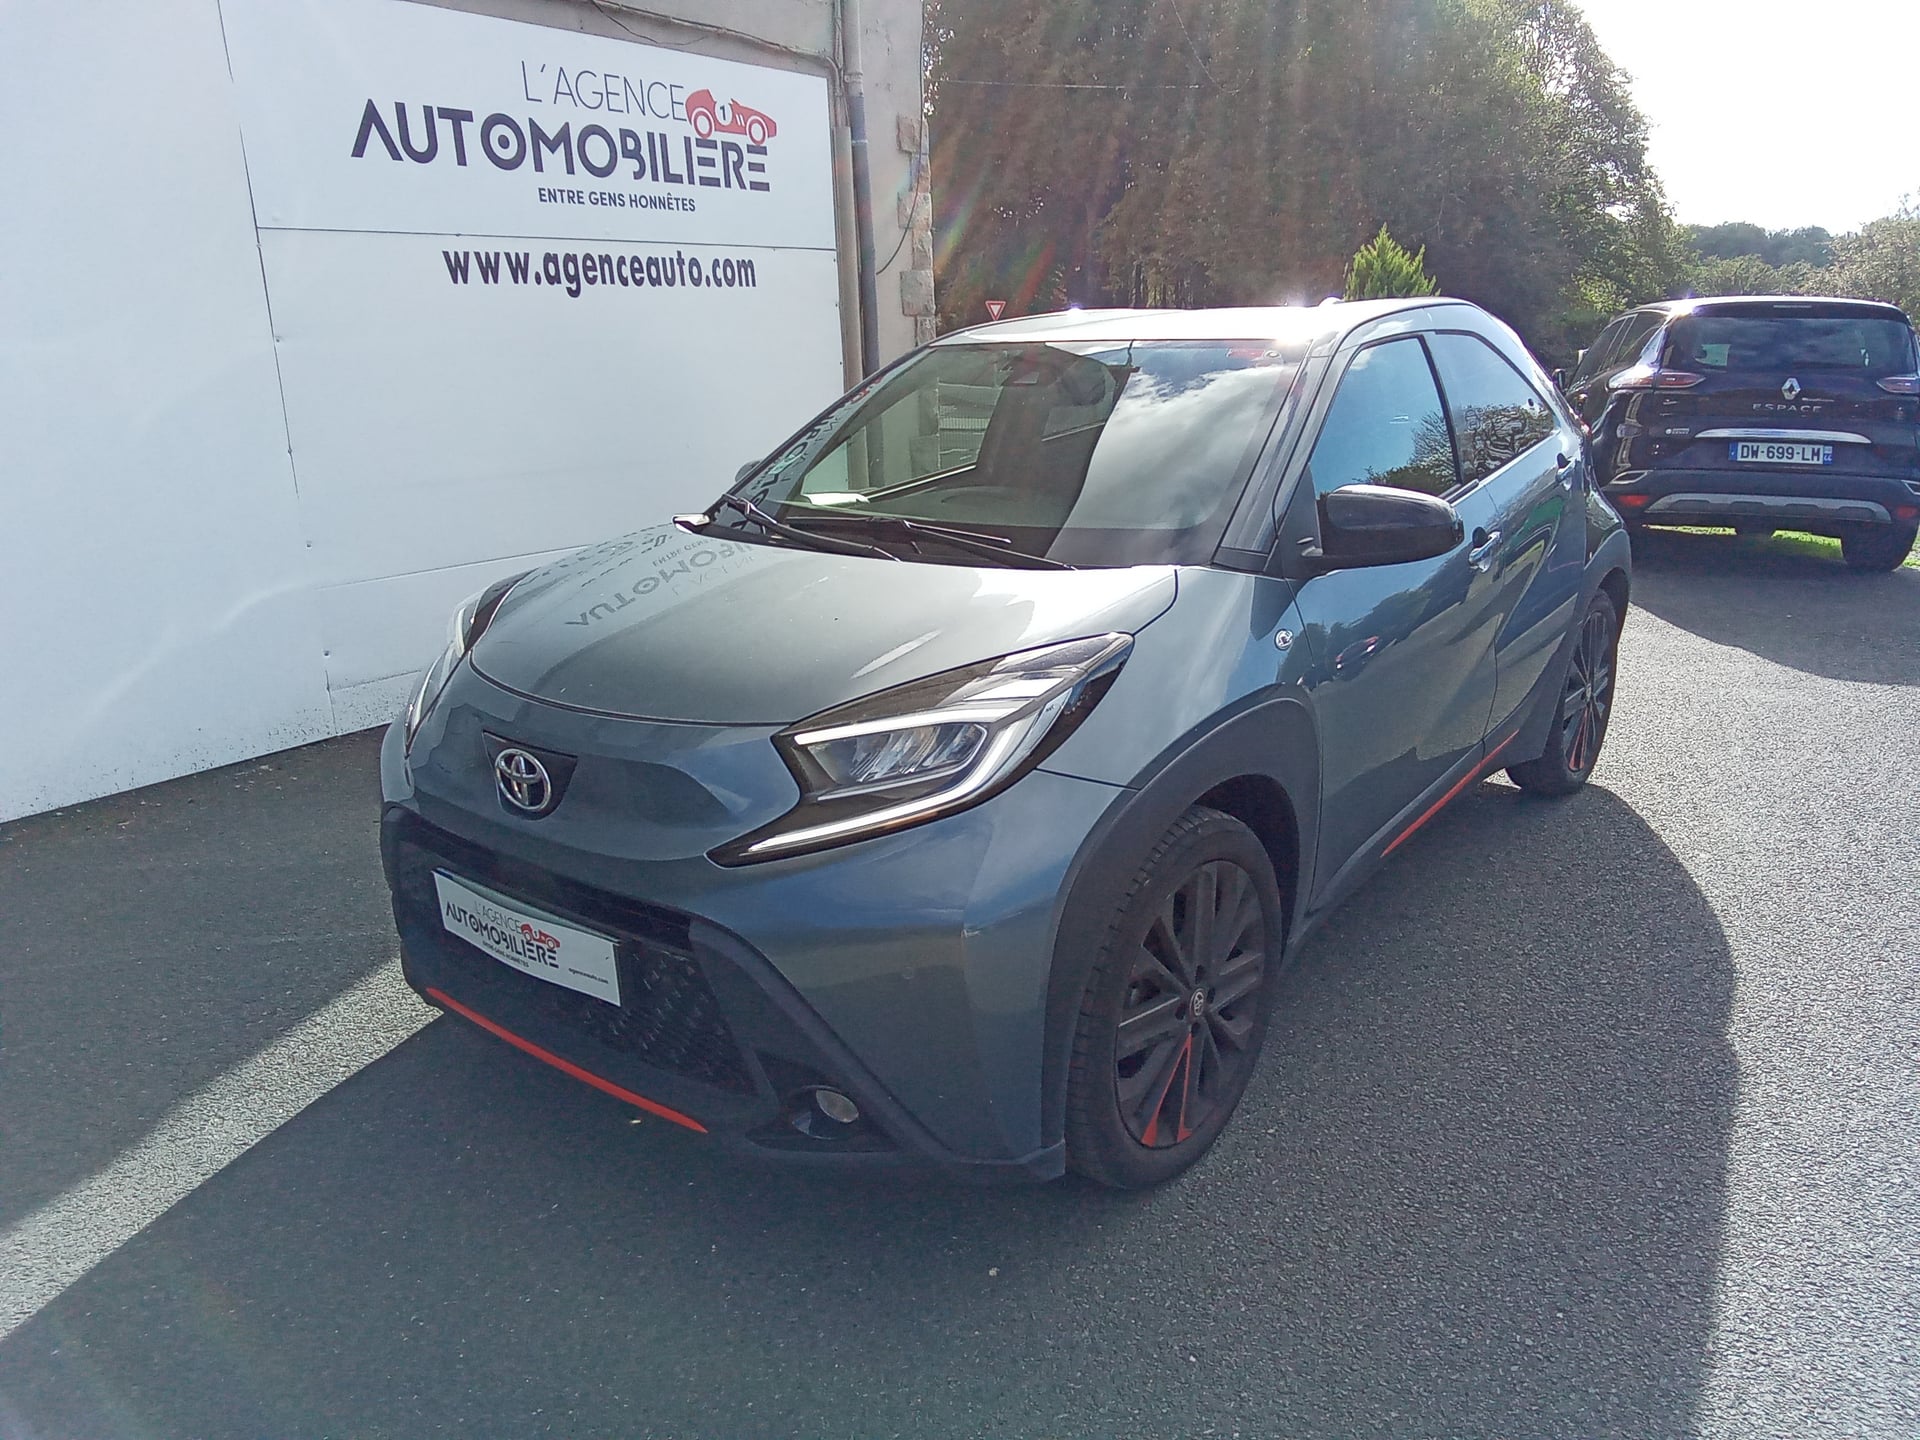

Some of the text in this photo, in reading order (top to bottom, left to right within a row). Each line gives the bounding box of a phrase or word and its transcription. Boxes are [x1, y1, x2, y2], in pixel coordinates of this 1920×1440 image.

[521, 60, 688, 122] L'AGENCE
[350, 98, 771, 193] AUTOMOBILIERE
[538, 187, 697, 212] ENTRE GENS HONNÊTES
[442, 249, 757, 298] www.agenceauto.com
[1752, 403, 1822, 413] ESPACE
